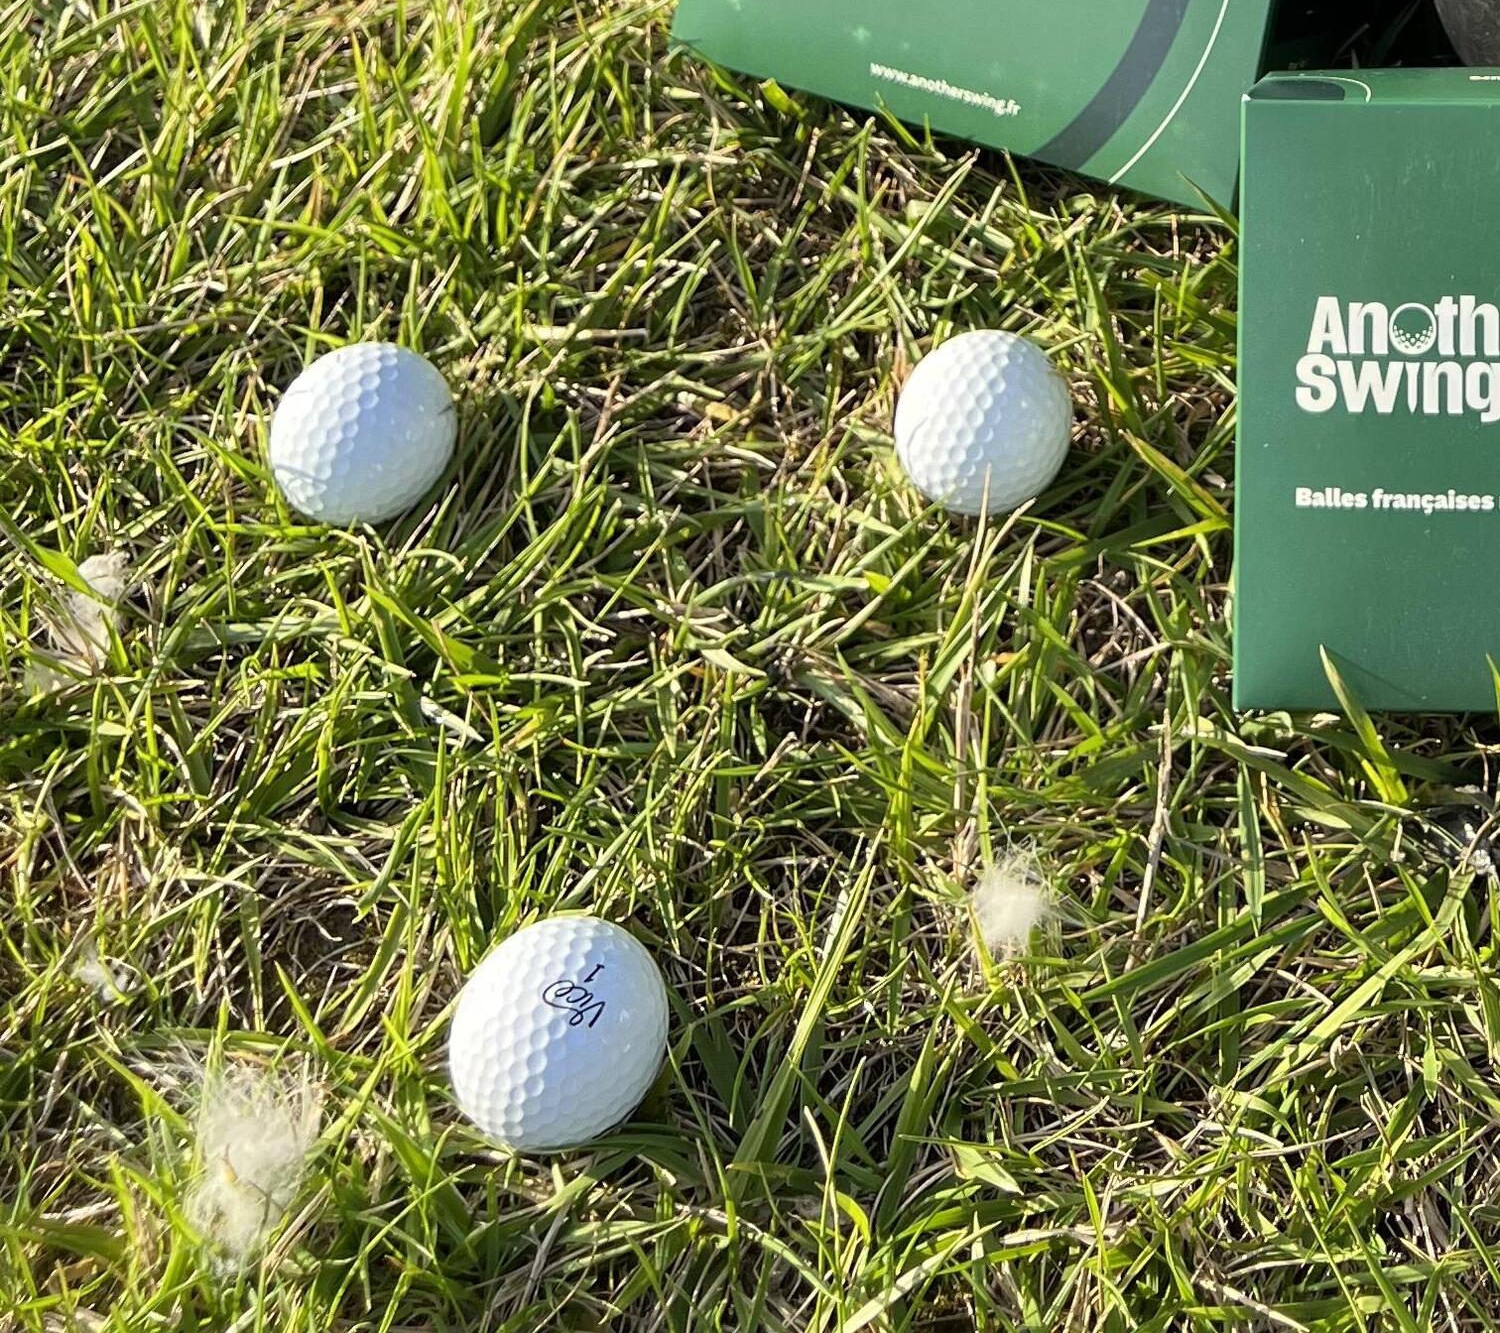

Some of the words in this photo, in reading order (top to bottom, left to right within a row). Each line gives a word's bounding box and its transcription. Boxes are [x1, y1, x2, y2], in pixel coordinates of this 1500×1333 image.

[870, 62, 1022, 116] www.anotherswing.fr
[1295, 487, 1368, 509] Balles
[1371, 488, 1495, 516] françaises
